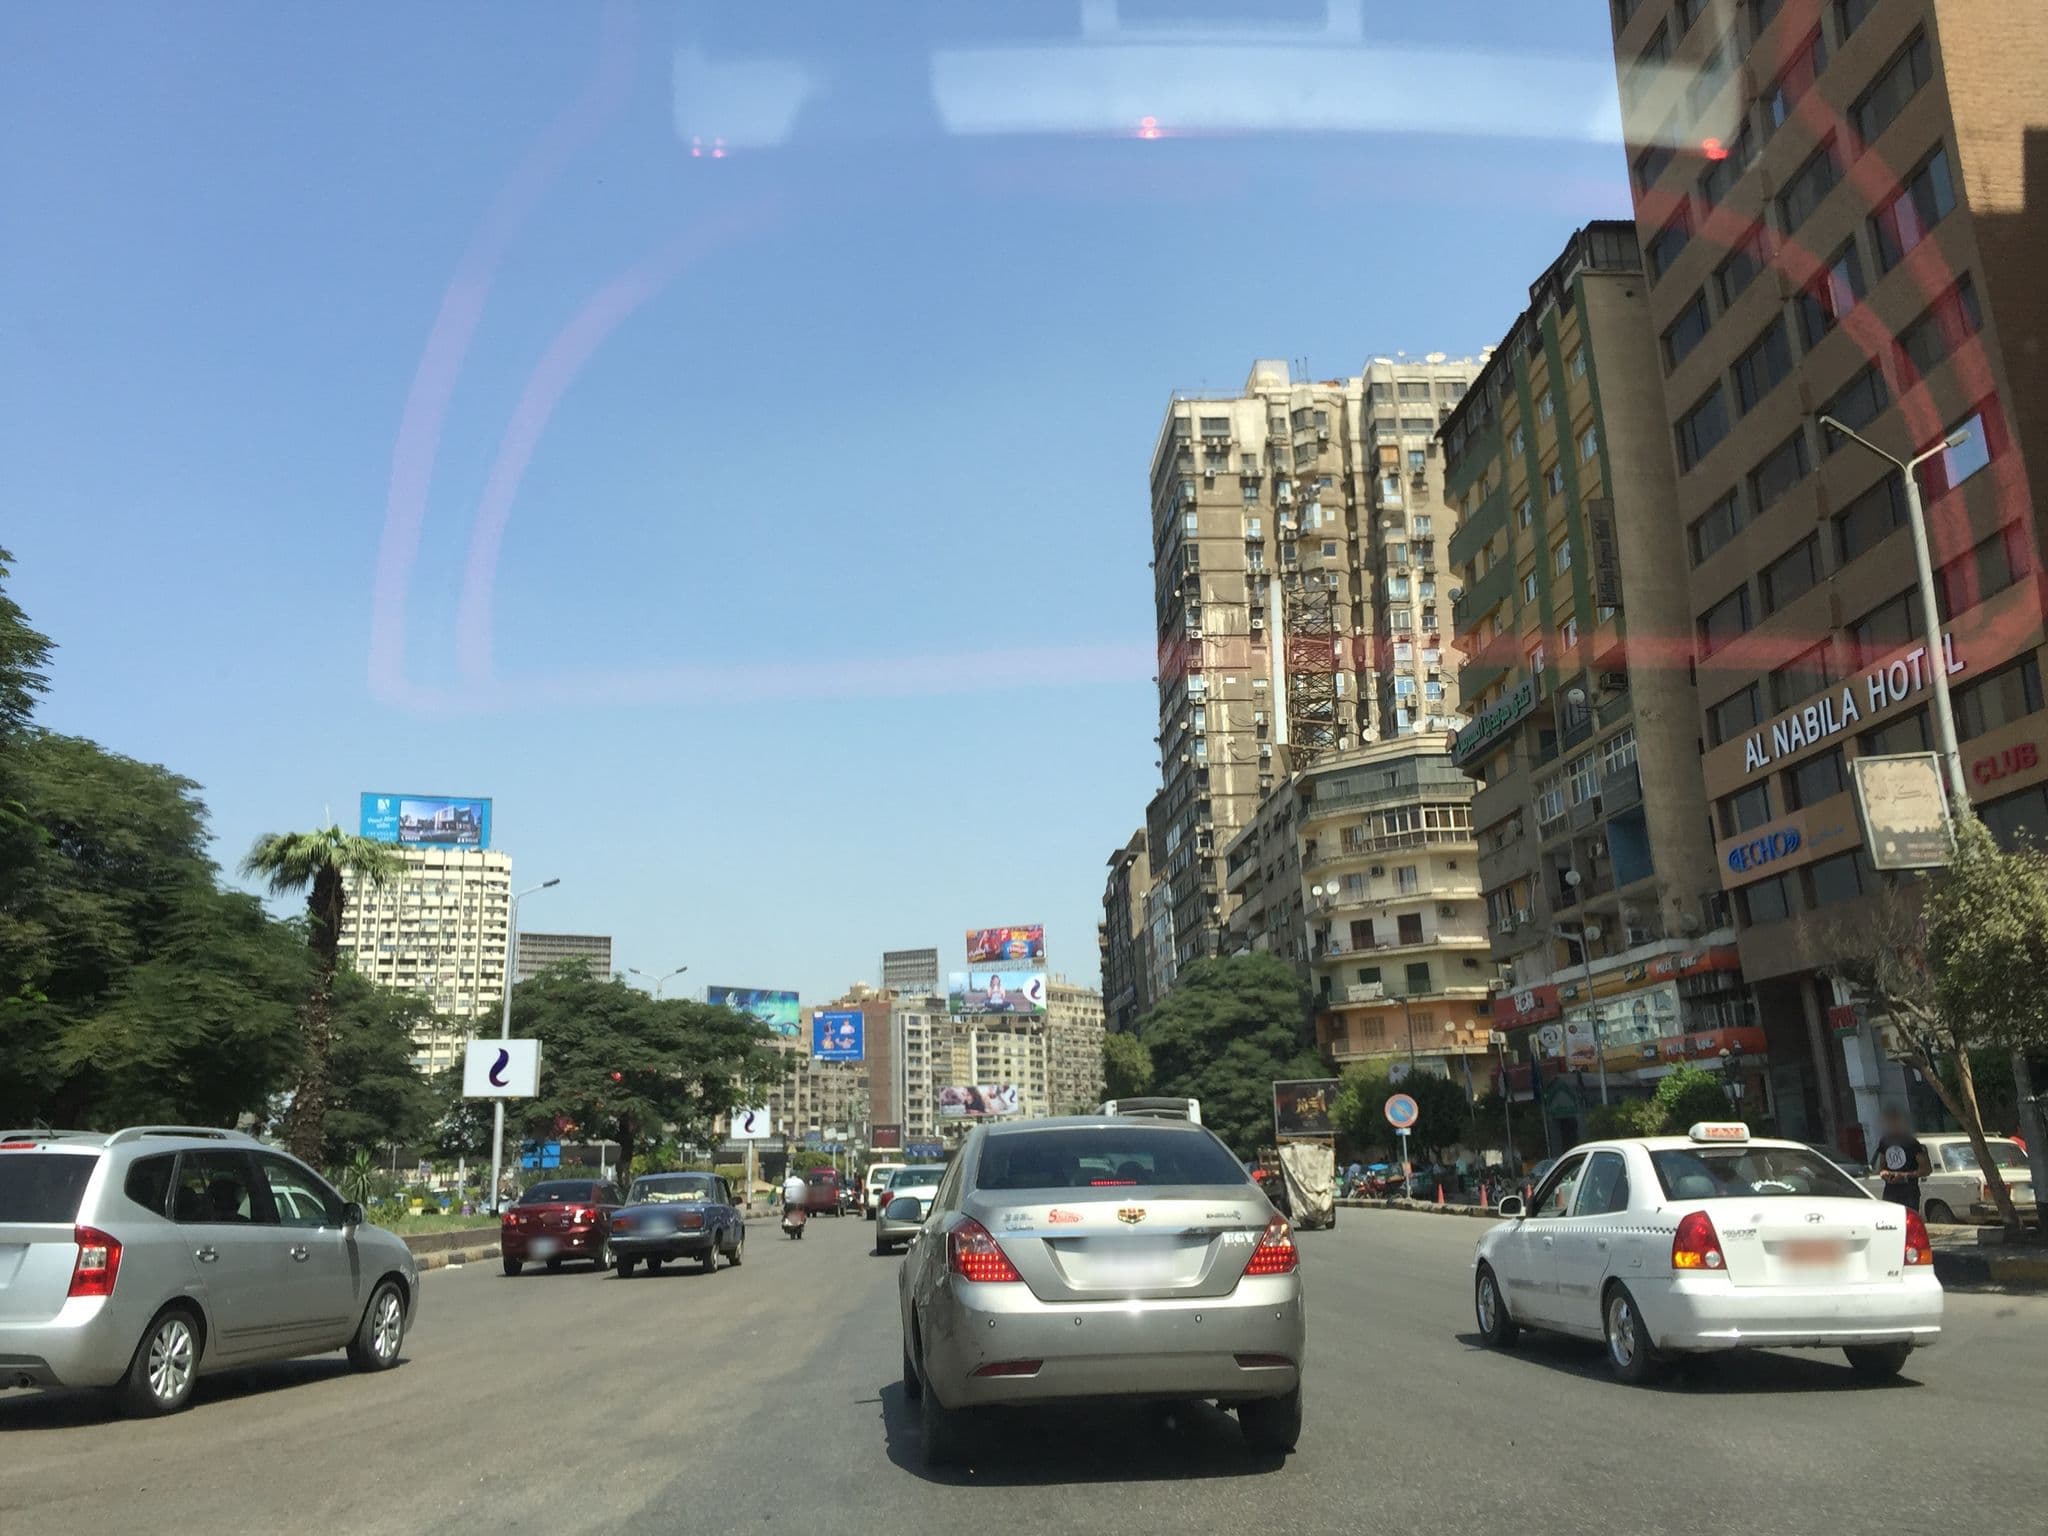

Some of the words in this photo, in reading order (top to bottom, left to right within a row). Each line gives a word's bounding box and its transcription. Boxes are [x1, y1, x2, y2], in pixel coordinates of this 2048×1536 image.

[1745, 732, 1771, 773] AL
[1772, 687, 1860, 759] NABILA
[1866, 633, 1965, 713] HOTL
[1972, 742, 2039, 785] CLUB
[1733, 829, 1793, 872] ECHO
[1704, 1127, 1744, 1138] TAXI
[1223, 1231, 1255, 1243] EGY
